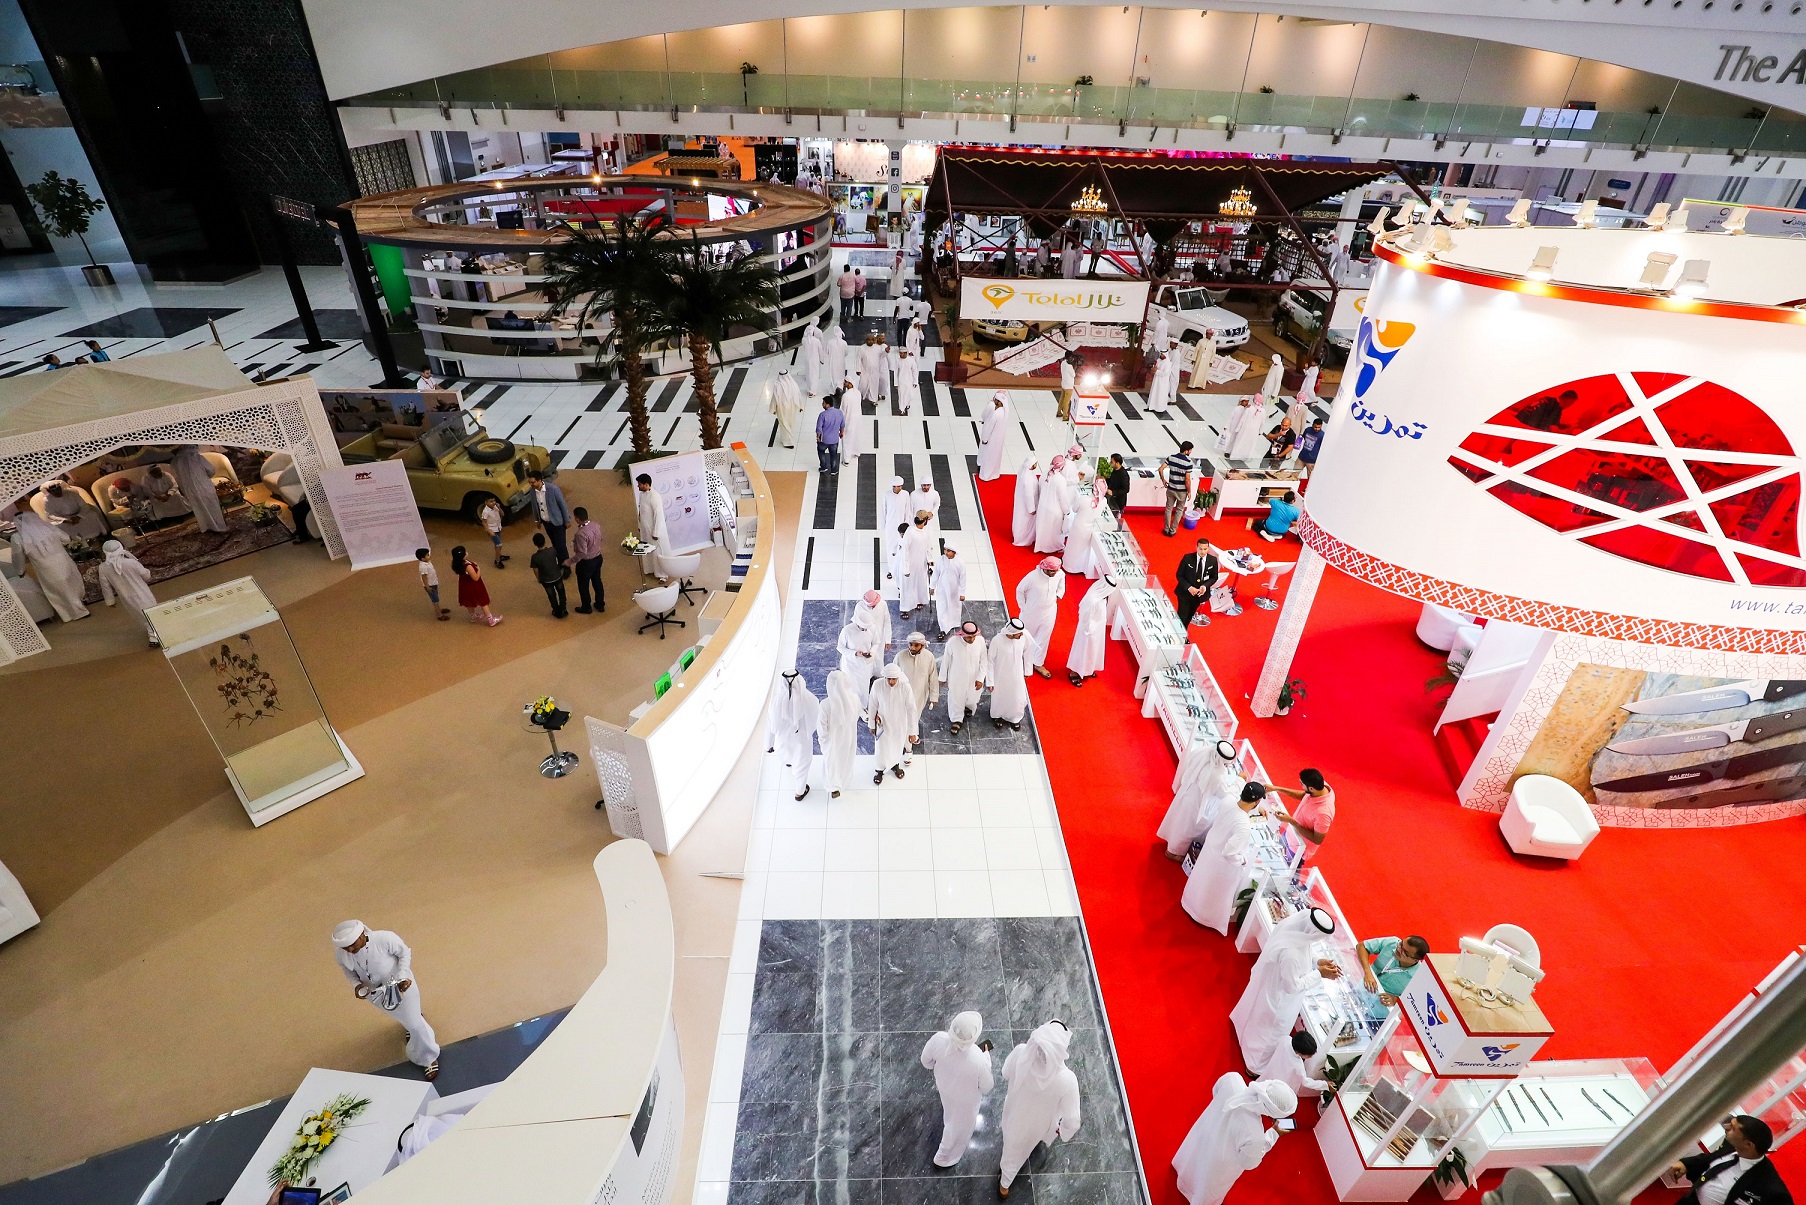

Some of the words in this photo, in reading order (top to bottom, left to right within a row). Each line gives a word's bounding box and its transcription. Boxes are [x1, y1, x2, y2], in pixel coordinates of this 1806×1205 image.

[1713, 45, 1779, 83] The
[1776, 48, 1806, 85] A
[1351, 400, 1428, 440] تمرين
[1730, 599, 1806, 616] www.ta
